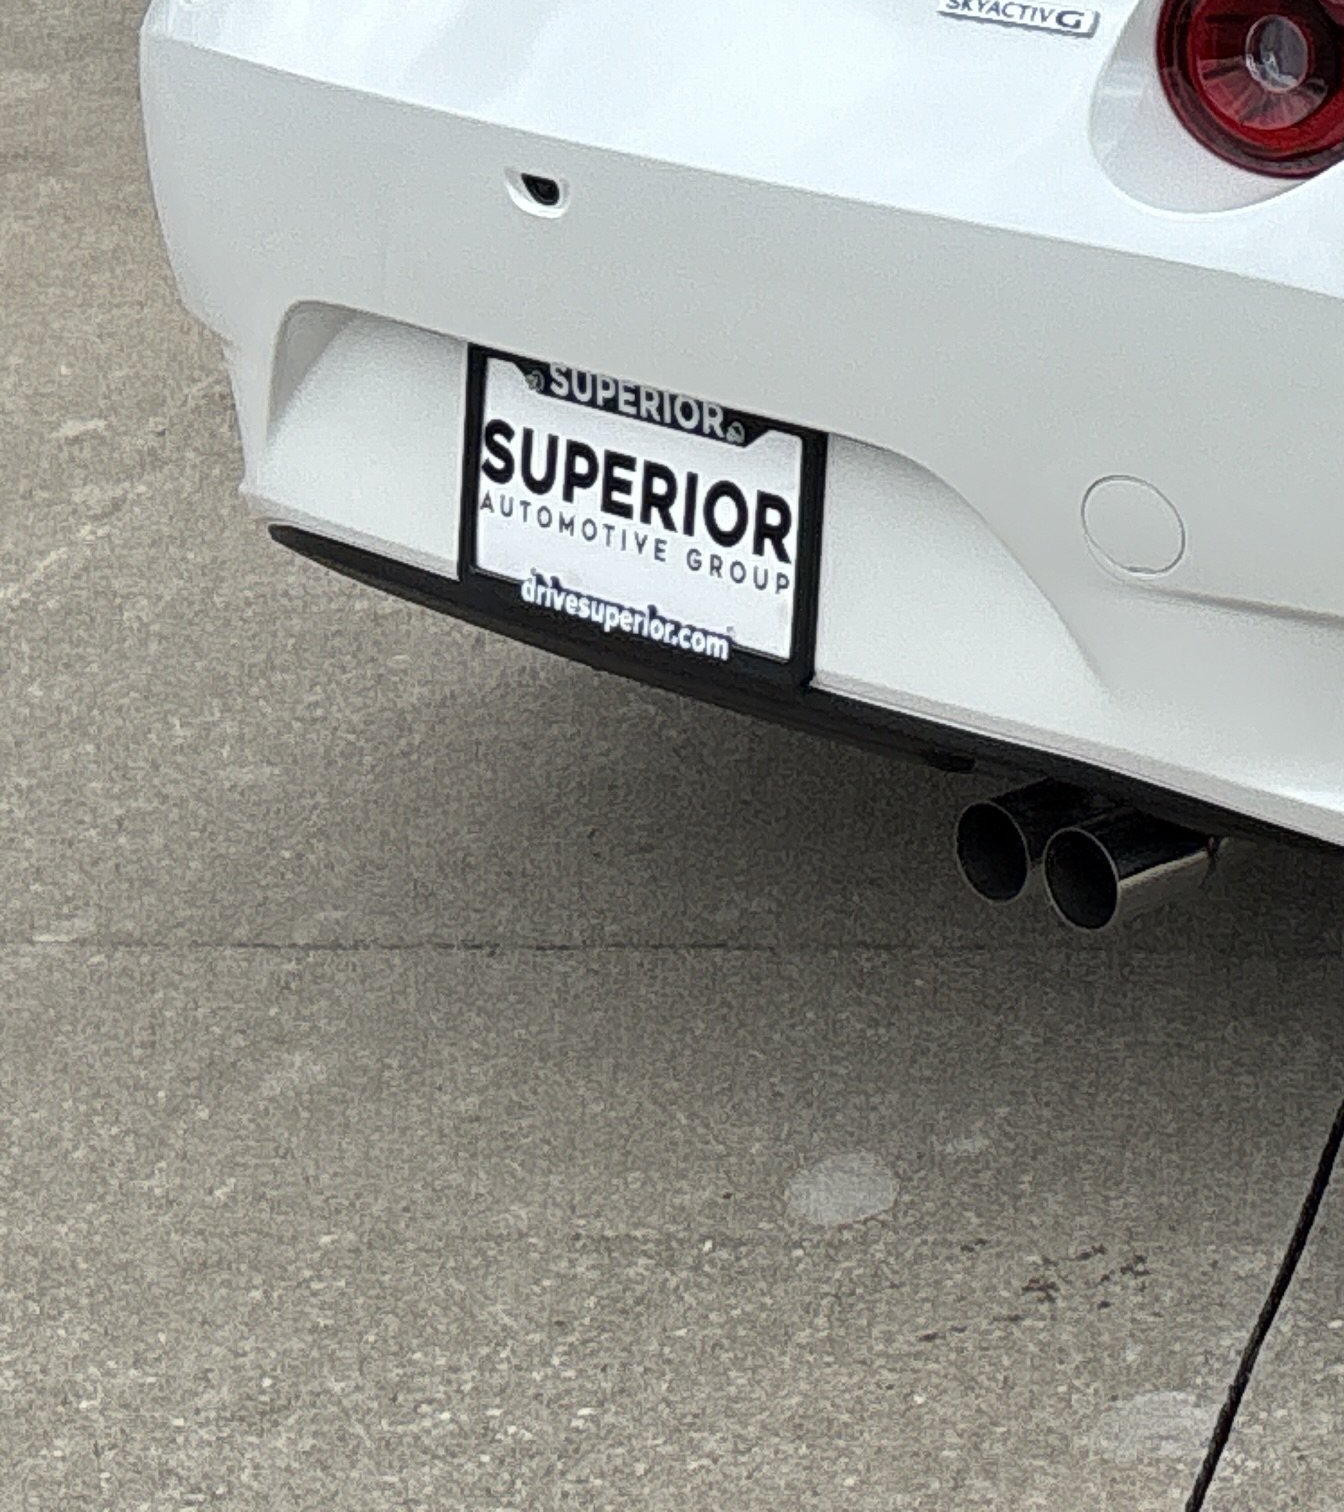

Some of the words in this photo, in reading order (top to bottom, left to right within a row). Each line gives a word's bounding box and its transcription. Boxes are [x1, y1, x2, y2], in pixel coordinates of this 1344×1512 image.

[549, 364, 726, 438] SUPERIOR
[482, 419, 792, 564] SUPERIOR
[480, 490, 667, 563] AUTOMOTIVE
[687, 548, 790, 595] GROUP
[521, 573, 730, 661] drivesuperior.com
